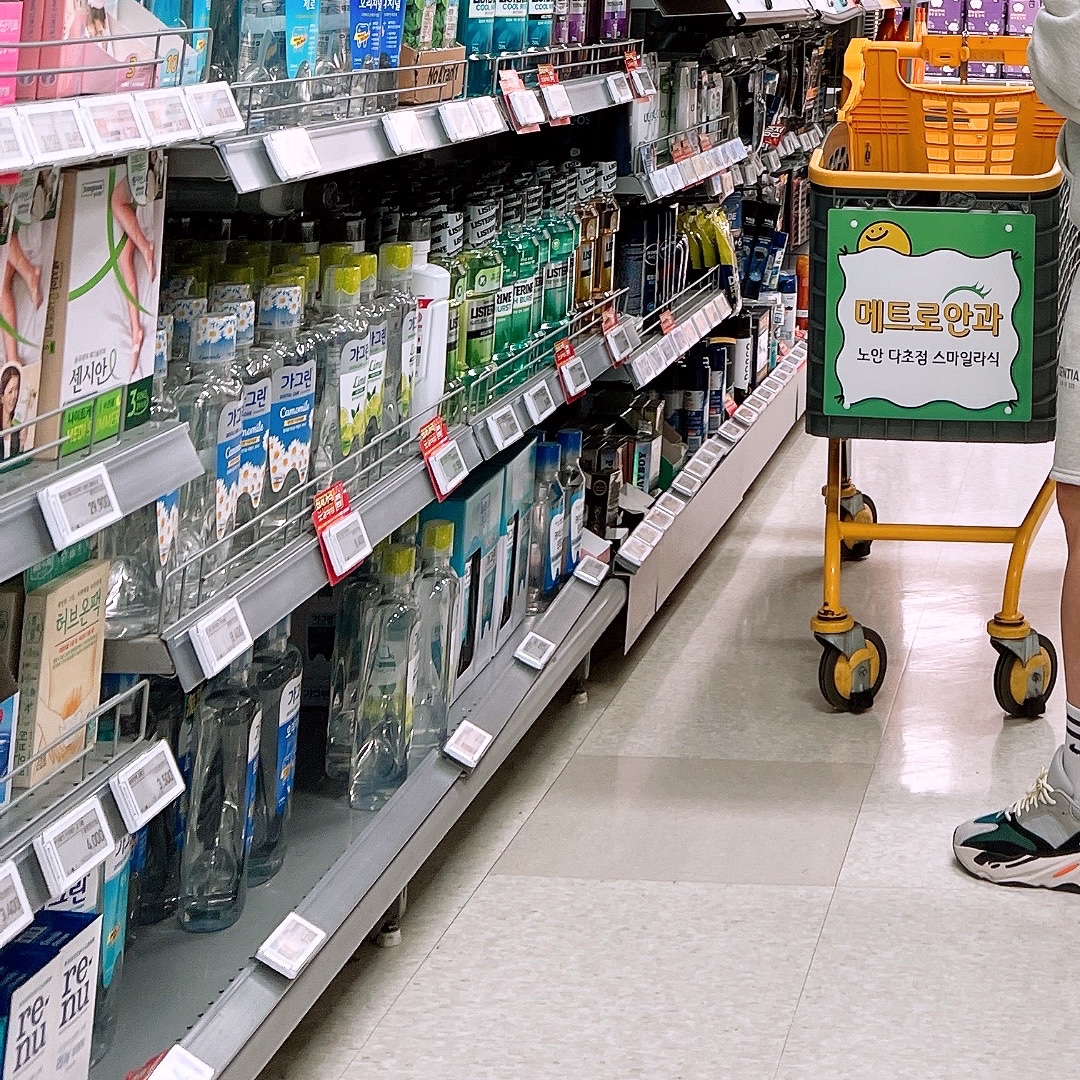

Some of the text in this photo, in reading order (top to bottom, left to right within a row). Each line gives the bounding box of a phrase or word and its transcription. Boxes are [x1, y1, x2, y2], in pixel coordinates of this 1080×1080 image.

[513, 282, 534, 296] TERINE
[855, 298, 1003, 338] 메트로안과
[856, 348, 1000, 367] 노안 다초점 스마일라식
[69, 360, 108, 394] 센시안
[280, 370, 313, 391] 가그린
[244, 386, 268, 408] 그린
[279, 403, 310, 419] Camomile
[56, 591, 101, 634] 허브온팩
[59, 980, 90, 1028] nu
[14, 1022, 46, 1074] nu
